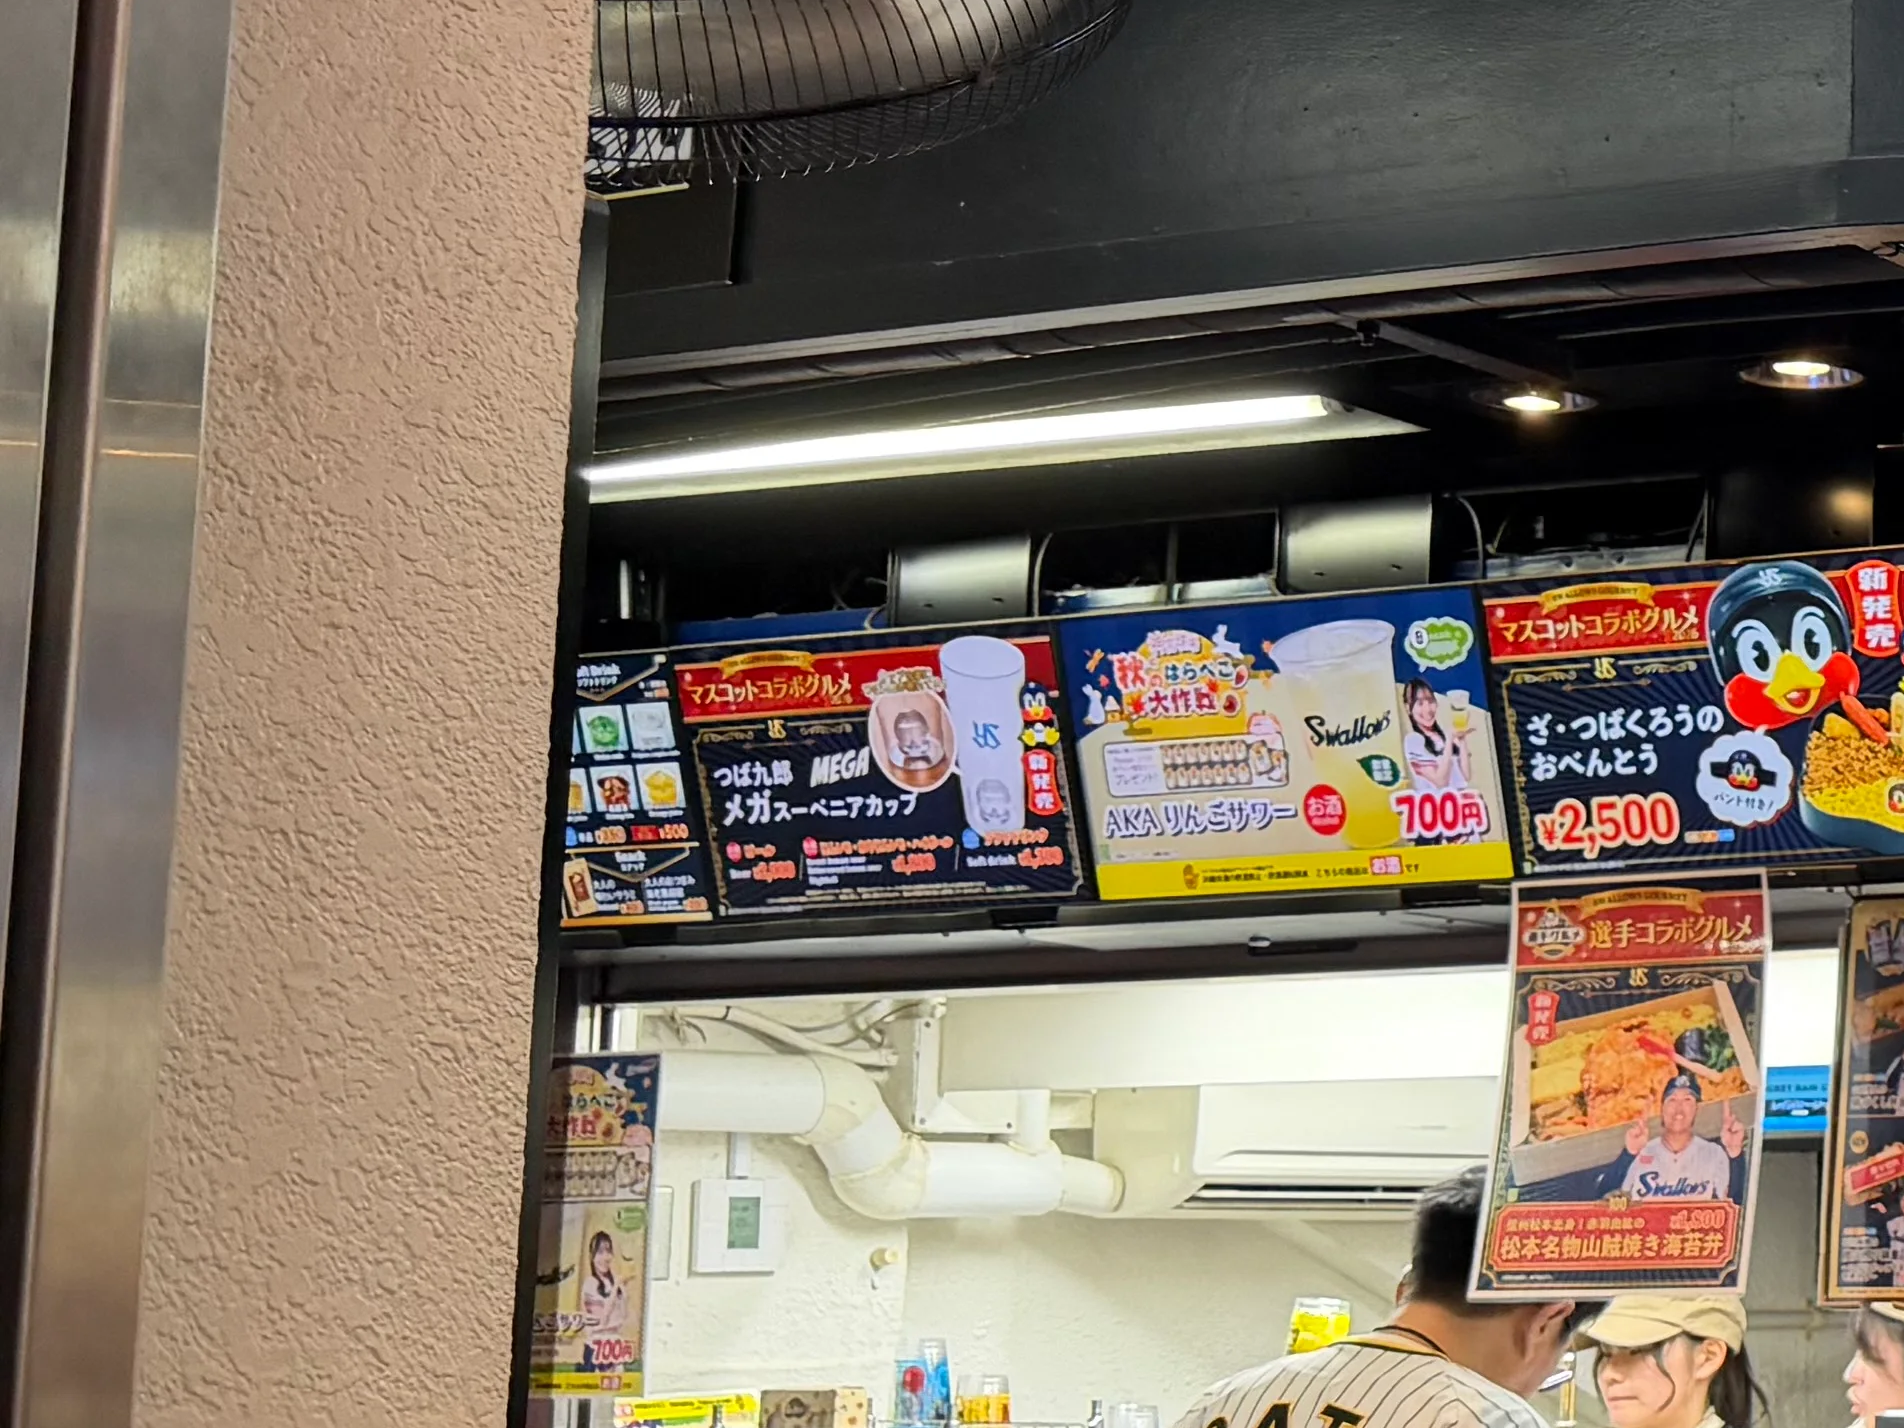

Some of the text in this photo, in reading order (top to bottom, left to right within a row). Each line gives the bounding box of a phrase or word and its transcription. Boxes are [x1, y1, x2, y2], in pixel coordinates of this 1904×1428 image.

[1500, 606, 1698, 642] マスコットコラボグルメ
[1859, 567, 1897, 648] 新発売
[689, 673, 852, 705] マスコットコラボグルメ
[1305, 711, 1391, 747] Swallows
[1527, 705, 1723, 745] ざ・つばくろうの
[714, 761, 793, 788] つば九郎
[811, 746, 869, 787] MEGA
[1531, 749, 1658, 782] おべんとう
[1106, 797, 1297, 838] AKA りんごサワー
[1308, 794, 1342, 816] お酒
[1397, 792, 1486, 834] 700円
[1538, 794, 1677, 855] ¥2,500
[1590, 915, 1752, 949] 選手コラボグルメ
[1638, 1172, 1709, 1197] Swallows
[592, 1341, 633, 1361] 700円
